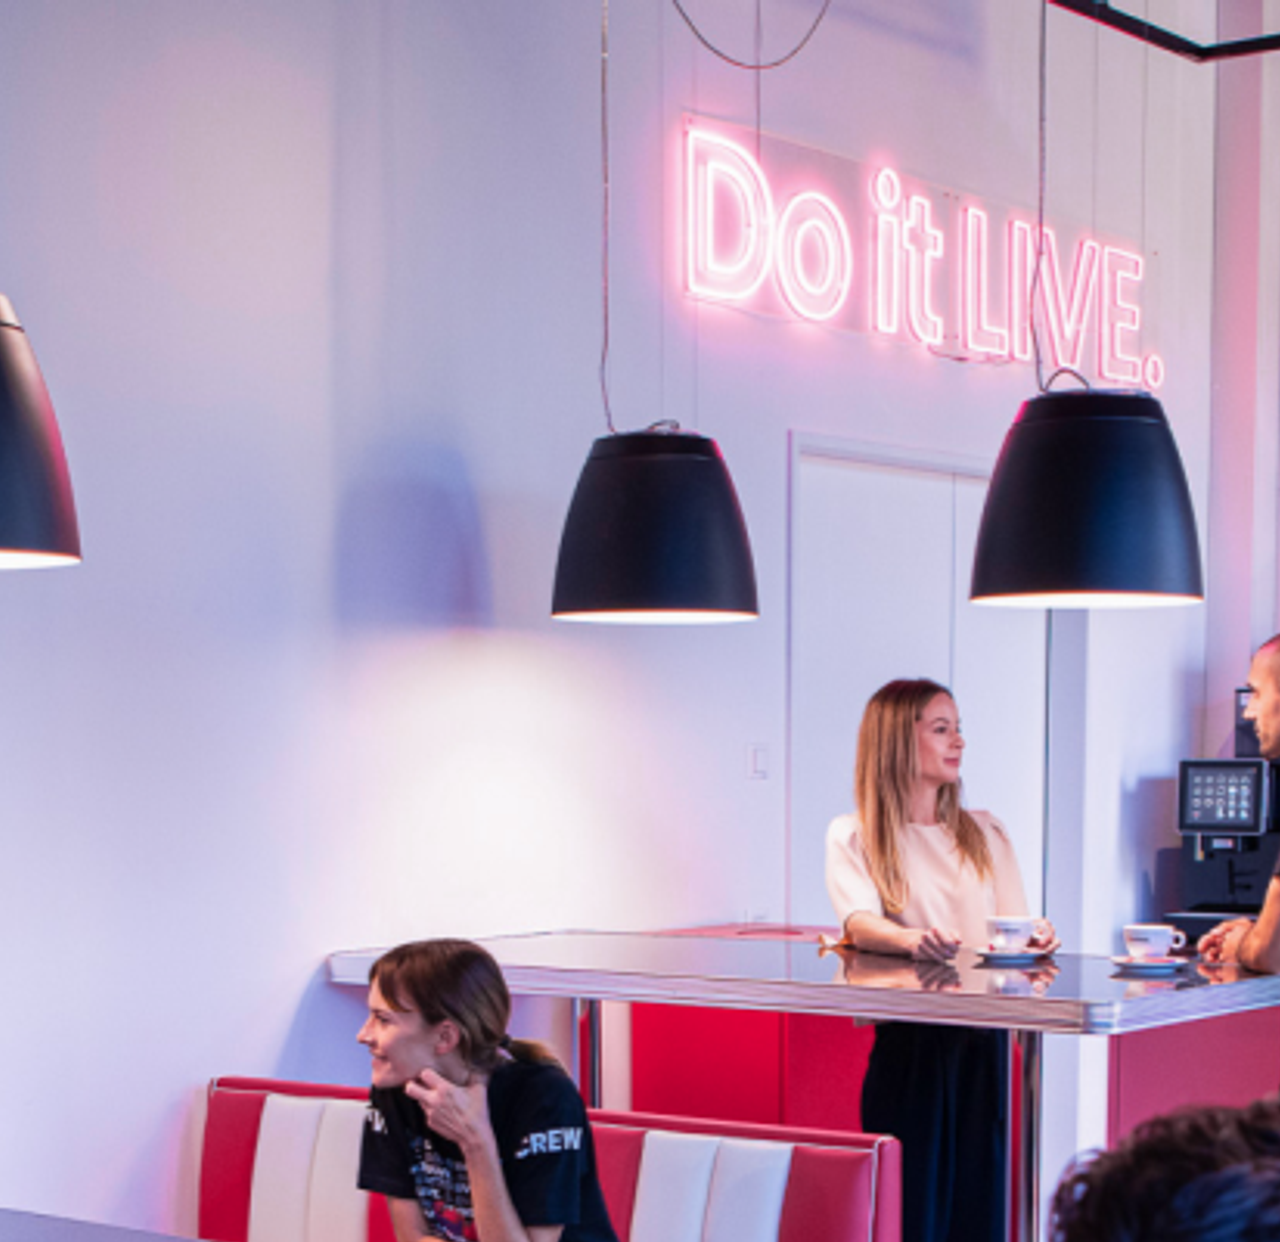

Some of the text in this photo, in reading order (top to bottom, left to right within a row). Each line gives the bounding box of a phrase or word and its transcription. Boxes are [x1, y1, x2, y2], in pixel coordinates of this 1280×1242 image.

[685, 129, 1166, 389] Do it LIVE.
